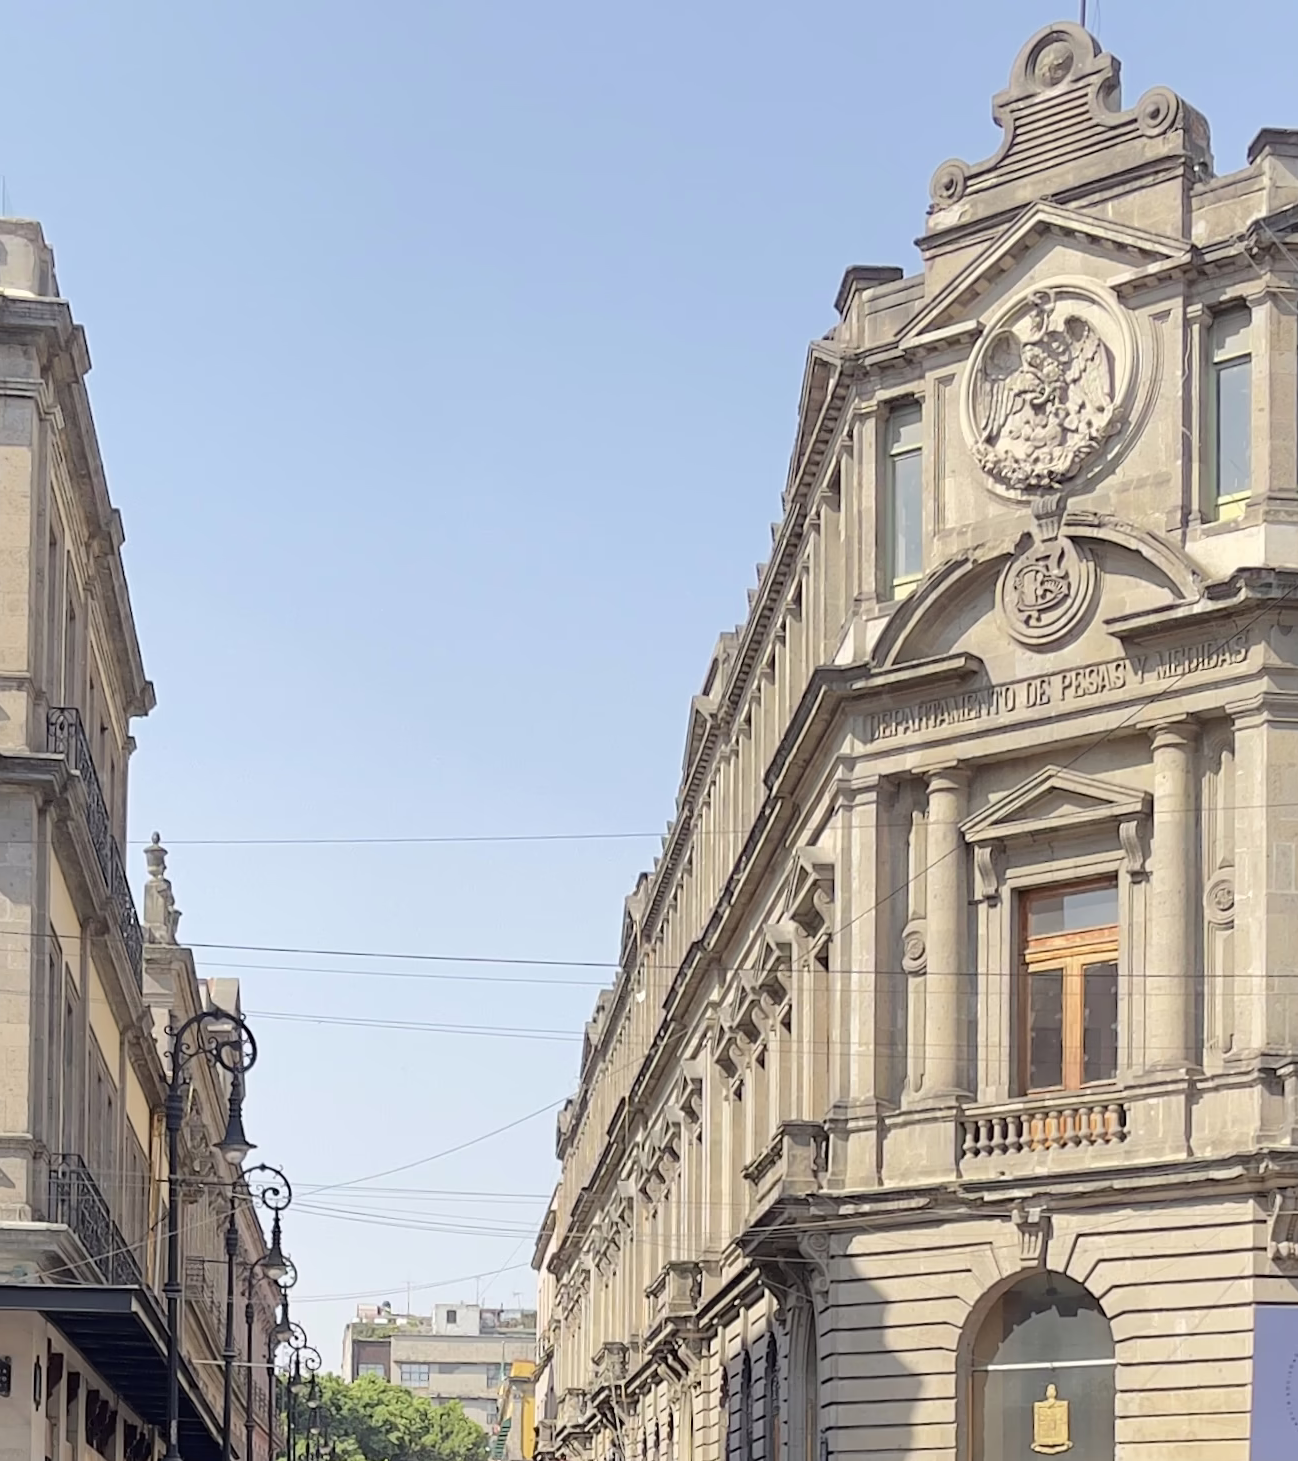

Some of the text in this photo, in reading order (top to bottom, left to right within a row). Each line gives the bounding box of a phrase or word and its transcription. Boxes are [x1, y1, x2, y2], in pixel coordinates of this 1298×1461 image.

[869, 633, 1249, 741] DEPARTAMENTO DE PESAS Y MEDIDAS
